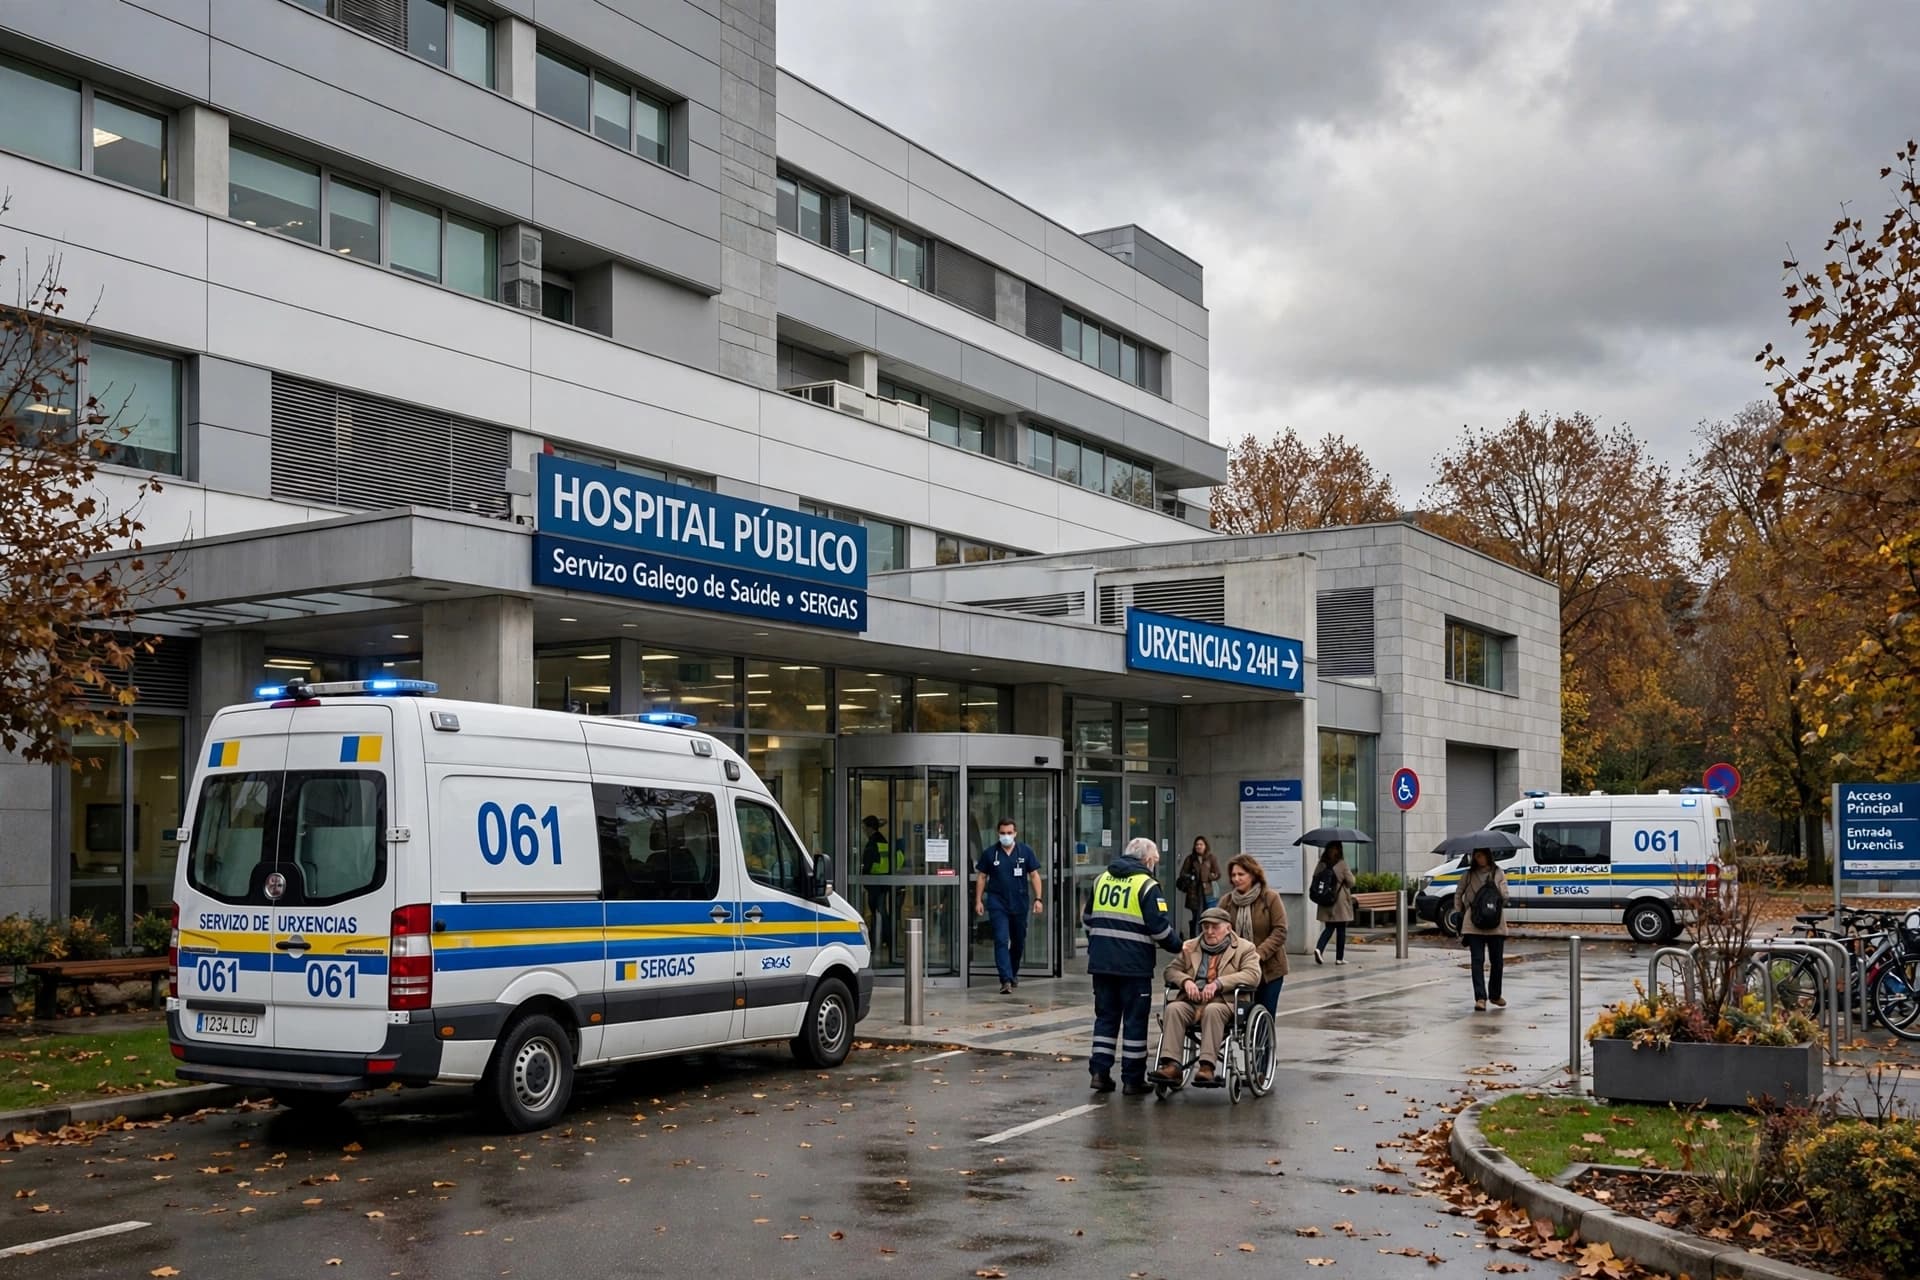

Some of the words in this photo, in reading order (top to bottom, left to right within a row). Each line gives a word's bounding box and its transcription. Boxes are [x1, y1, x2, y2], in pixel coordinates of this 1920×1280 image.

[554, 473, 724, 550] HOSPITAL
[734, 508, 857, 574] PÚBLICO
[553, 548, 627, 583] Servizo
[633, 562, 698, 598] Galego
[703, 574, 725, 598] de
[731, 579, 780, 607] Saúde
[800, 591, 858, 620] SERGAS
[1138, 622, 1241, 671] URXENCIAS
[1246, 642, 1278, 677] 24H
[1846, 790, 1892, 801] Acceso
[1847, 802, 1903, 816] Principal
[477, 801, 562, 866] 061
[1634, 829, 1679, 852] 061
[1847, 827, 1893, 837] Entrada
[1099, 884, 1131, 909] 061
[200, 913, 249, 931] SERVIZO
[253, 914, 270, 930] DE
[278, 915, 357, 934] URXENCIAS
[198, 959, 237, 993] 061
[640, 955, 695, 979] SERGAS
[307, 963, 355, 999] 061
[204, 1016, 228, 1033] 1234
[232, 1017, 255, 1034] LGJ
